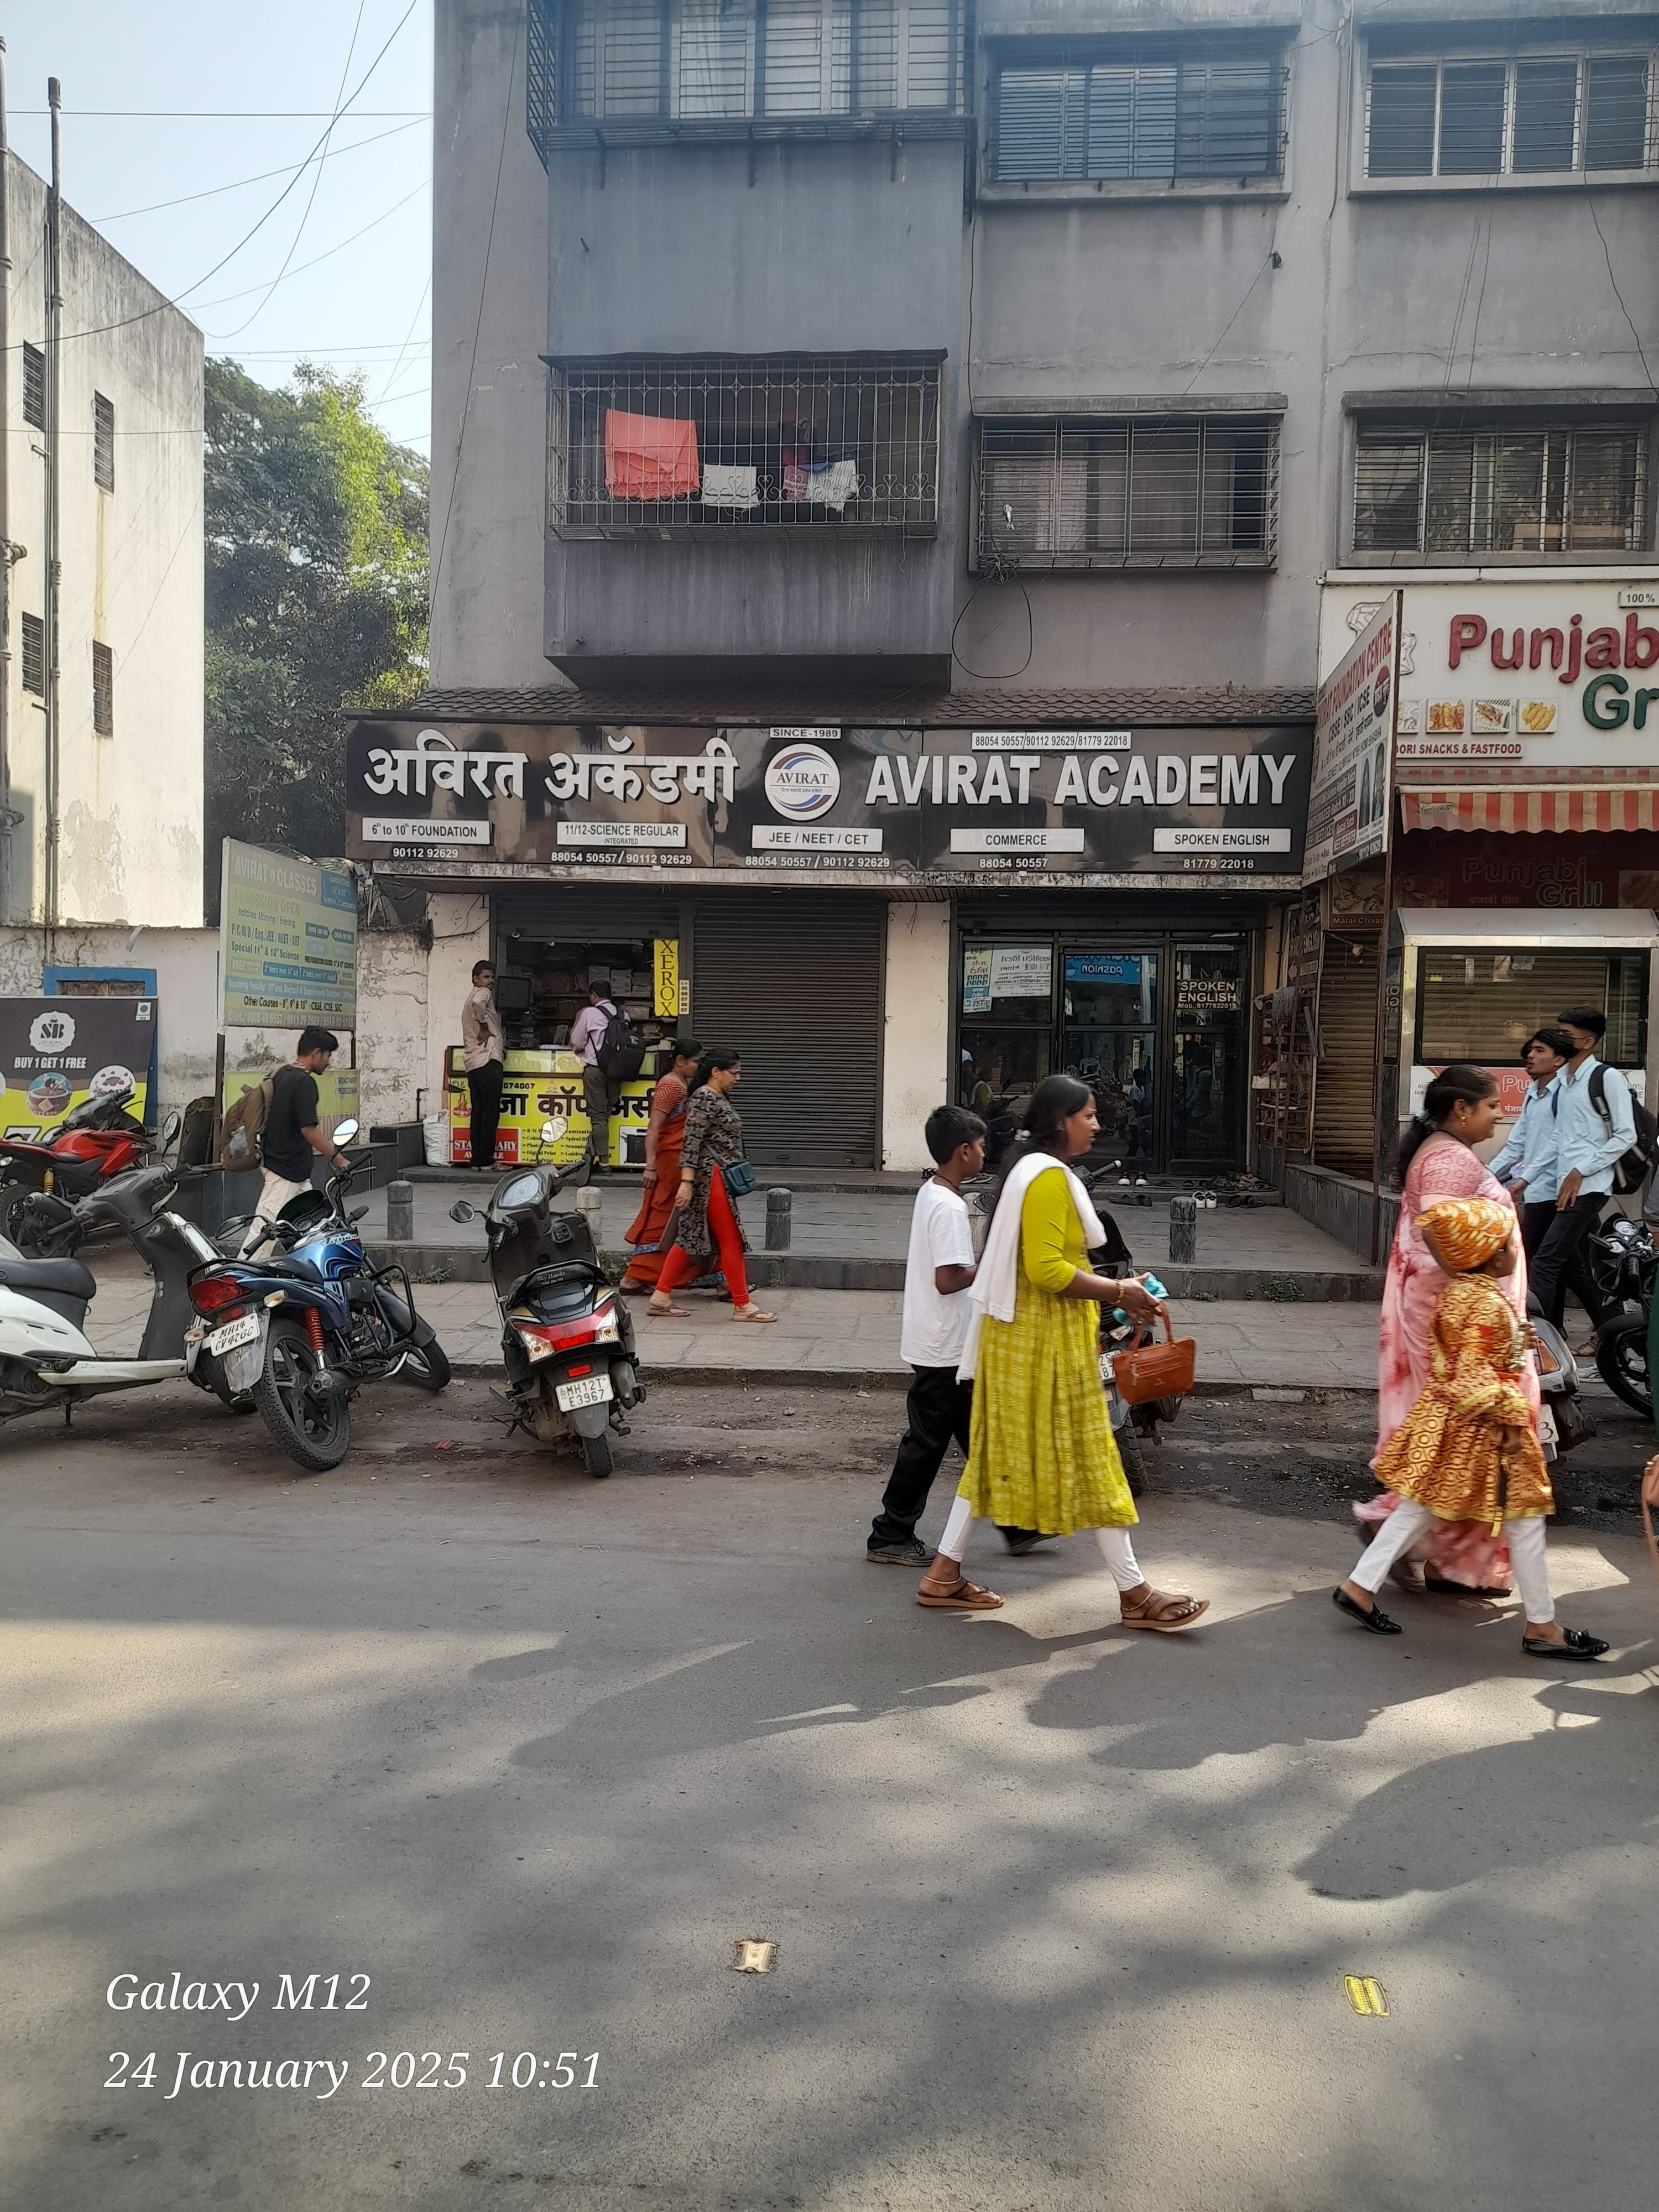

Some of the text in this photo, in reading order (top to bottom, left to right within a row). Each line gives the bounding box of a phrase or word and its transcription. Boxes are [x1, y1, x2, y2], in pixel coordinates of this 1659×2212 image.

[1626, 593, 1655, 603] 100%
[1366, 615, 1391, 679] CENTRE
[1343, 701, 1354, 730] SSC
[1357, 684, 1370, 716] ICSE
[975, 735, 998, 747] 88054
[1103, 735, 1128, 747] 22018
[1418, 743, 1459, 754] SNACKS
[1461, 744, 1469, 754] &
[1470, 743, 1522, 754] FASTFOOD
[363, 728, 530, 800] अविरत
[776, 772, 829, 785] AVIRAT
[864, 755, 1041, 805] AVIRAT
[1053, 754, 1297, 805] ACADEMY
[383, 826, 392, 835] to
[412, 825, 477, 837] FOUNDATION
[565, 825, 679, 837] 11/12-SCIENCE REGULAR
[769, 832, 792, 843] JEE
[802, 833, 834, 844] NEET
[844, 834, 869, 845] CET
[985, 834, 1047, 846] COMMERCE
[1174, 834, 1270, 845] SPOKEN ENGLISH
[393, 848, 458, 858] 90112 92629
[551, 852, 583, 863] 88054
[660, 854, 692, 864] 92629
[745, 856, 778, 866] 88054
[780, 857, 812, 867] 50557
[822, 857, 855, 868] 90112
[857, 858, 890, 868] 92629
[979, 858, 1048, 868] 88054 50557
[1183, 858, 1254, 869] 81779 22018
[234, 854, 268, 883] AVIRAT
[276, 867, 317, 896] CLASSES
[1463, 858, 1587, 889] Punjabi
[234, 888, 300, 916] ADMISSION OPEN
[231, 941, 252, 954] Special
[280, 949, 299, 961] Science
[659, 940, 676, 1016] XEROX
[1180, 981, 1235, 991] SPOKEN
[243, 997, 258, 1006] Other
[259, 998, 278, 1008] Courses
[1178, 992, 1237, 1003] ENGLISH
[14, 1057, 87, 1069] BUY 1 GET 1 FREE
[218, 1321, 246, 1340] MH14
[566, 1378, 602, 1396] MH12T
[568, 1388, 605, 1407] E3967
